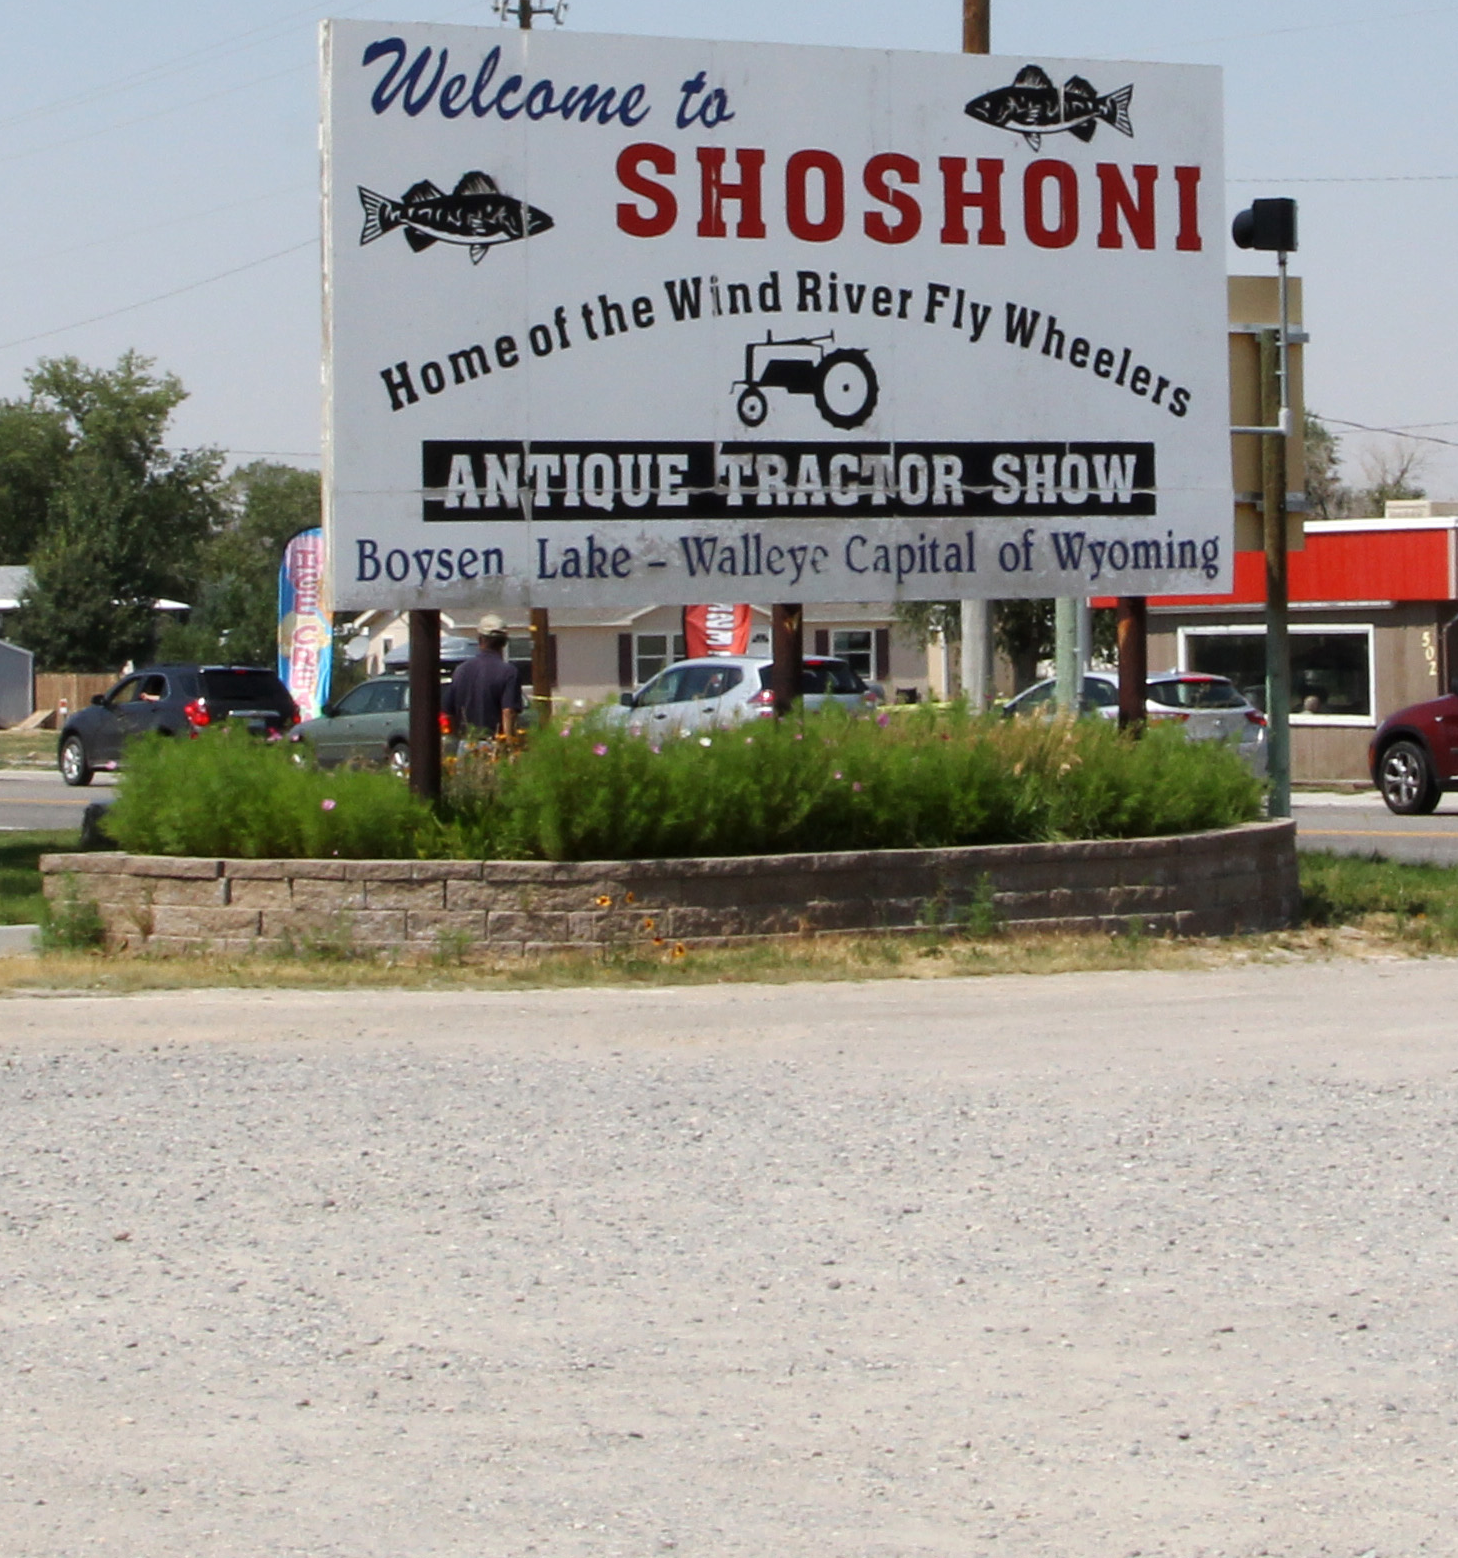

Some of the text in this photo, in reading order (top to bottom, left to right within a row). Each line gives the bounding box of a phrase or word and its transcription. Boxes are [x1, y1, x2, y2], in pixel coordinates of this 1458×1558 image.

[363, 37, 735, 130] Welcome to
[616, 143, 1203, 252] SHOSHONI
[379, 270, 1192, 418] Home of the Wind River Fly Wheelers
[444, 453, 1138, 512] ANTIQUE TRACTOR SHOW
[294, 549, 318, 615] ICE
[355, 538, 505, 587] Boysen
[537, 535, 632, 581] Lake
[678, 533, 829, 587] Walleye
[845, 529, 977, 584] Capital
[997, 527, 1036, 574] of
[1050, 529, 1221, 581] Wyoming
[1421, 631, 1438, 676] 502
